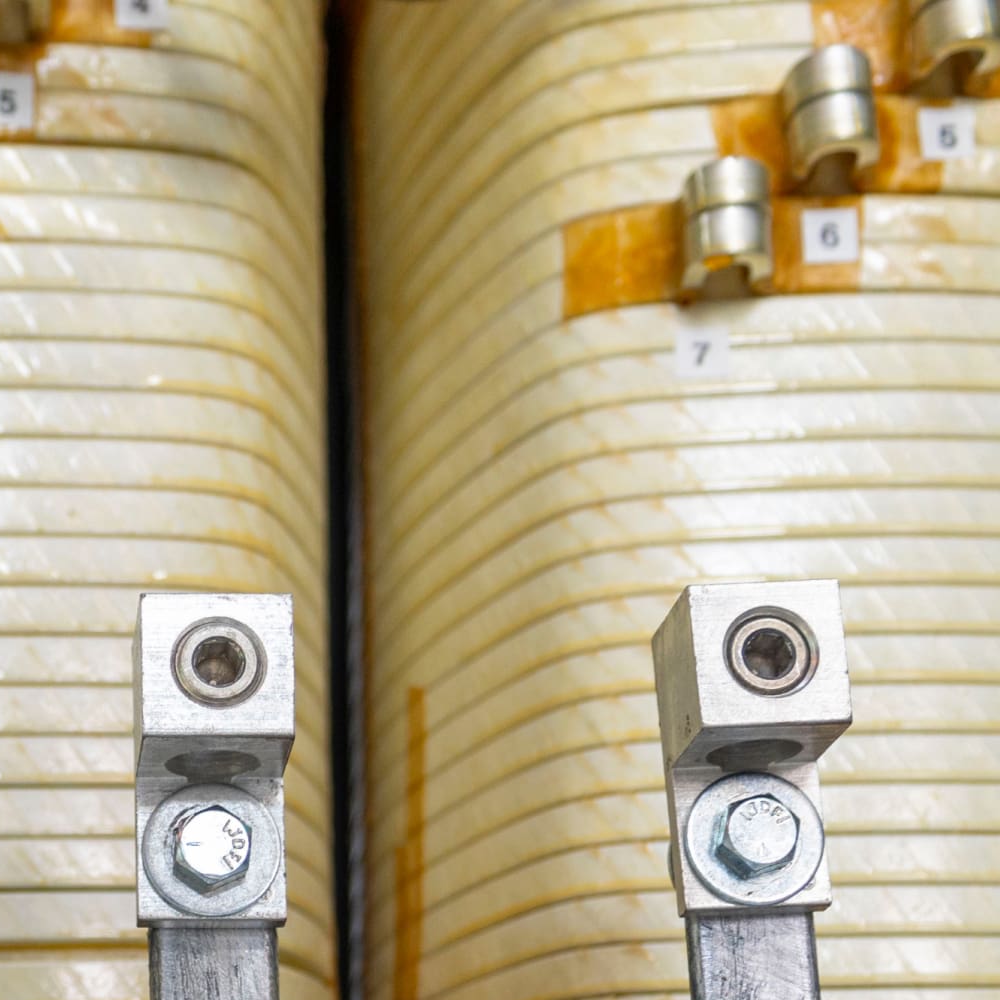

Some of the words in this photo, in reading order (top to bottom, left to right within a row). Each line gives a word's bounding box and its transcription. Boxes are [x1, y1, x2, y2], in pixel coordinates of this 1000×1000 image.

[938, 124, 957, 149] 5
[820, 222, 840, 248] 6
[692, 341, 711, 366] 7
